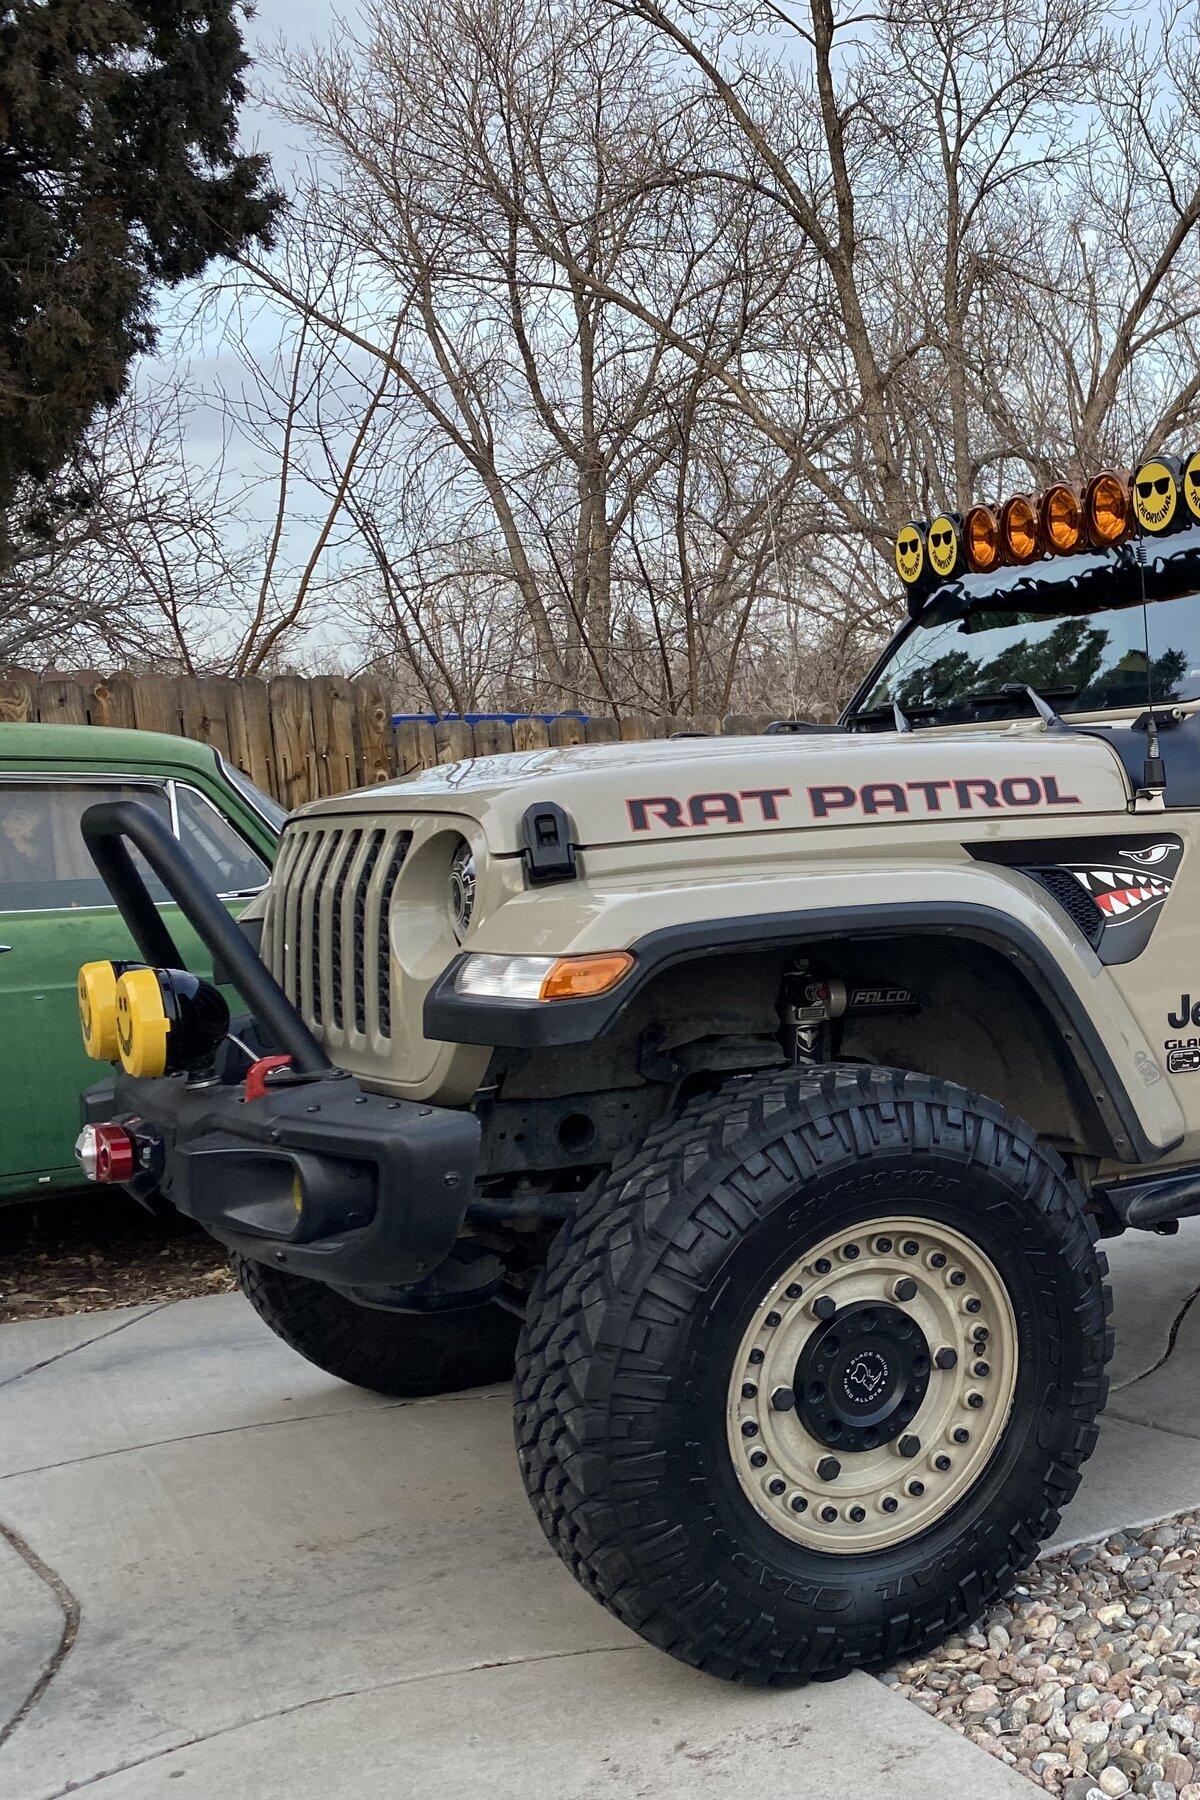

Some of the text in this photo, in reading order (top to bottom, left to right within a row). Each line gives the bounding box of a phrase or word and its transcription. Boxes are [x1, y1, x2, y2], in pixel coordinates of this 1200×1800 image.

[1145, 494, 1172, 524] ORIGINAL
[625, 775, 1083, 832] RAT PATROL
[850, 1351, 888, 1376] BLACK RHINO
[843, 1378, 882, 1403] HARD ALLOYS
